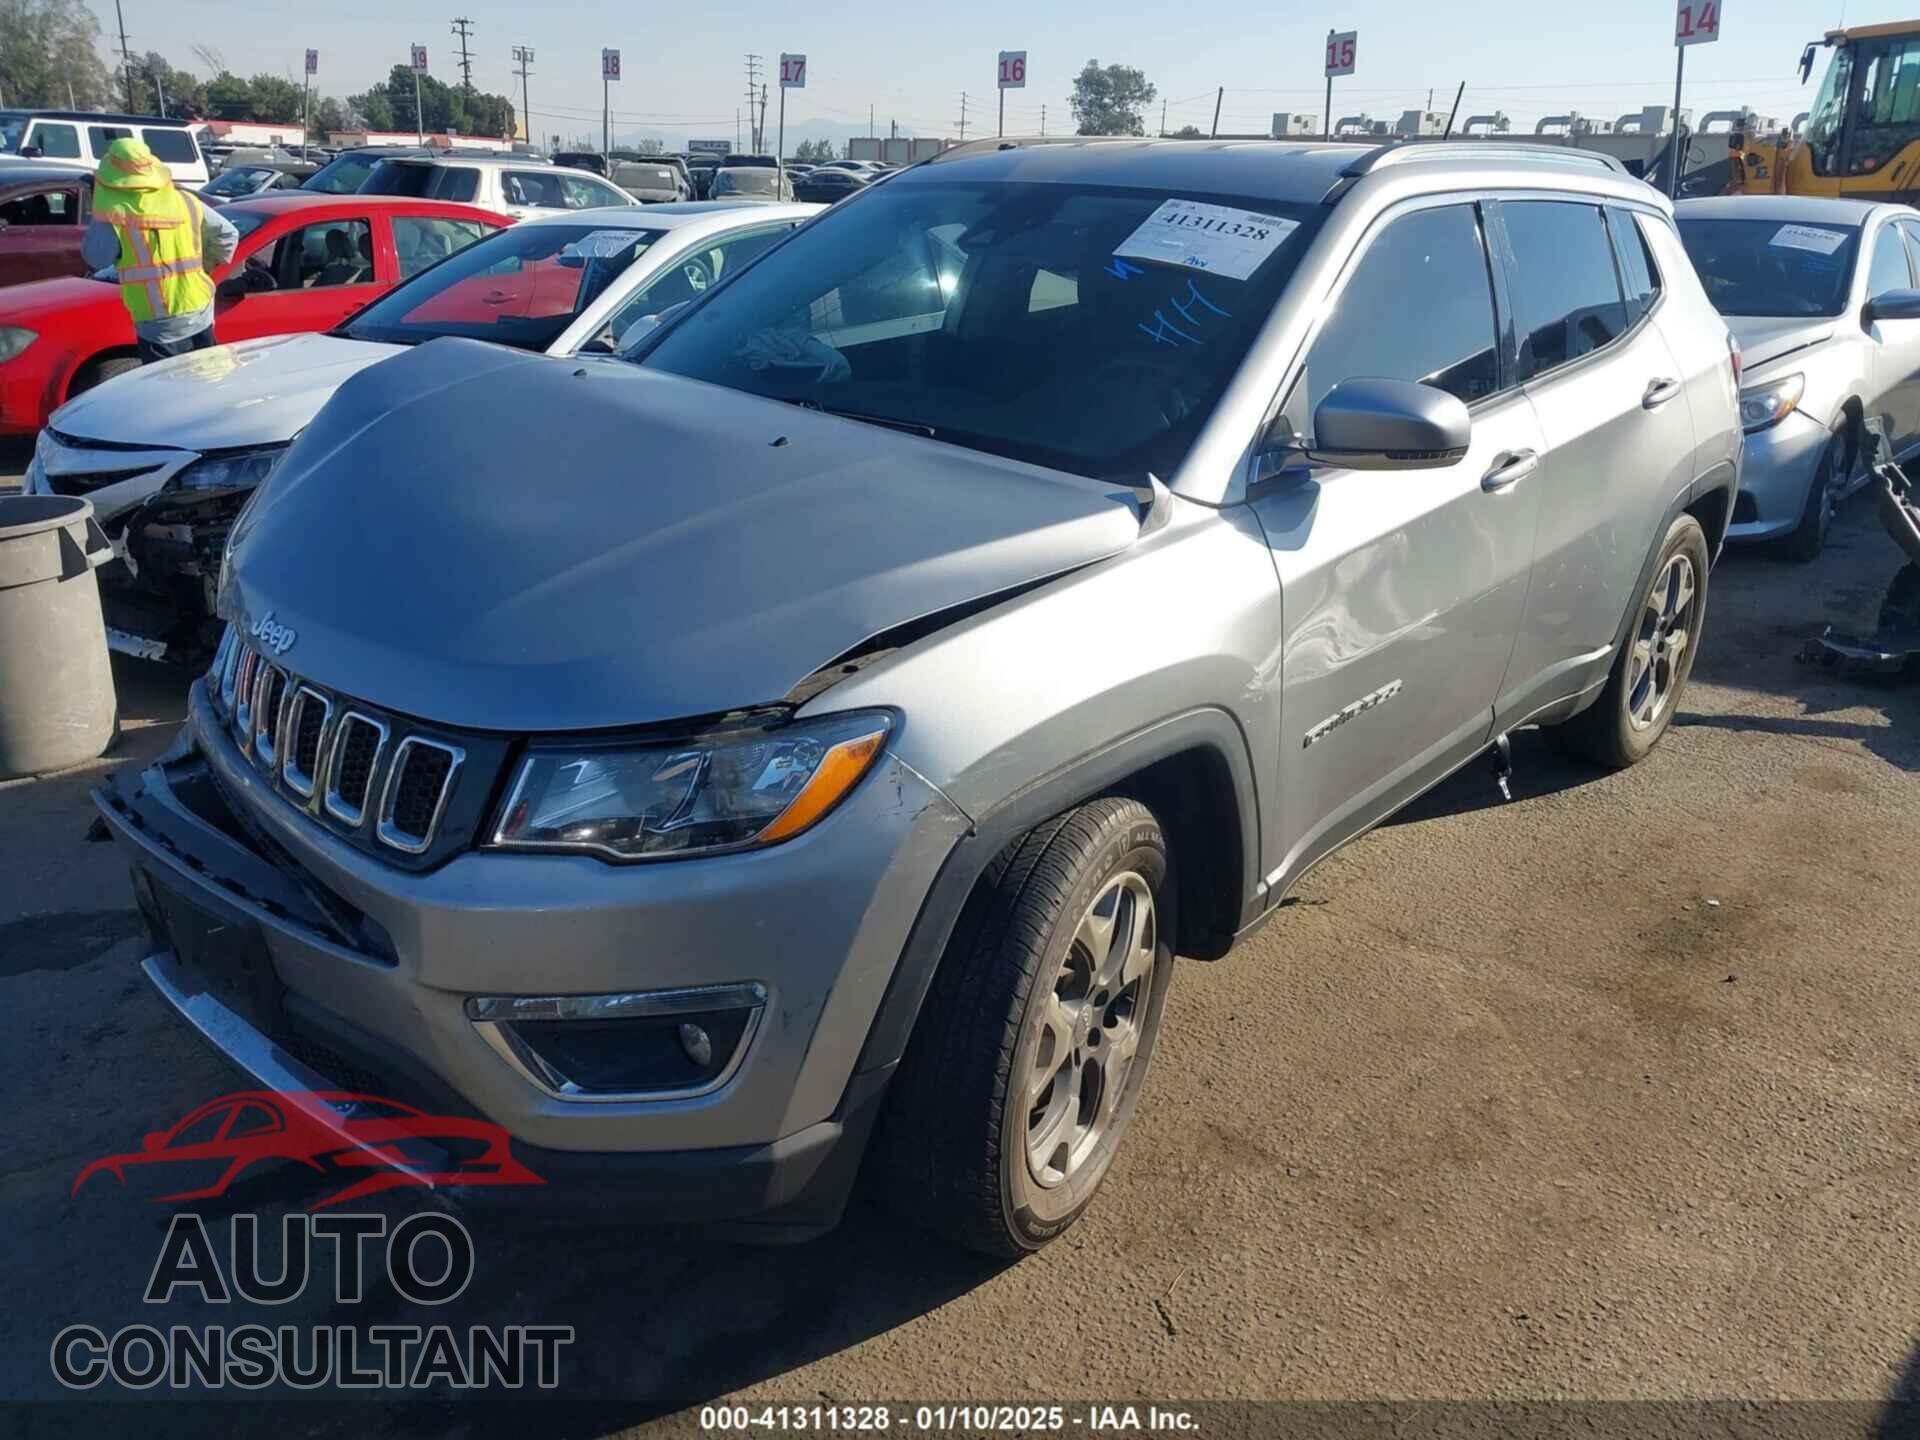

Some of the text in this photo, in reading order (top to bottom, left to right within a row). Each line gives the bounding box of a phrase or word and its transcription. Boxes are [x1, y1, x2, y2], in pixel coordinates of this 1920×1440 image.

[1677, 2, 1719, 38] 14
[411, 51, 427, 69] 19
[602, 55, 621, 75] 18
[1327, 39, 1355, 69] 15
[779, 60, 806, 82] 17
[1000, 58, 1026, 82] 16
[1162, 212, 1270, 241] 41311328
[251, 610, 297, 656] Jeep
